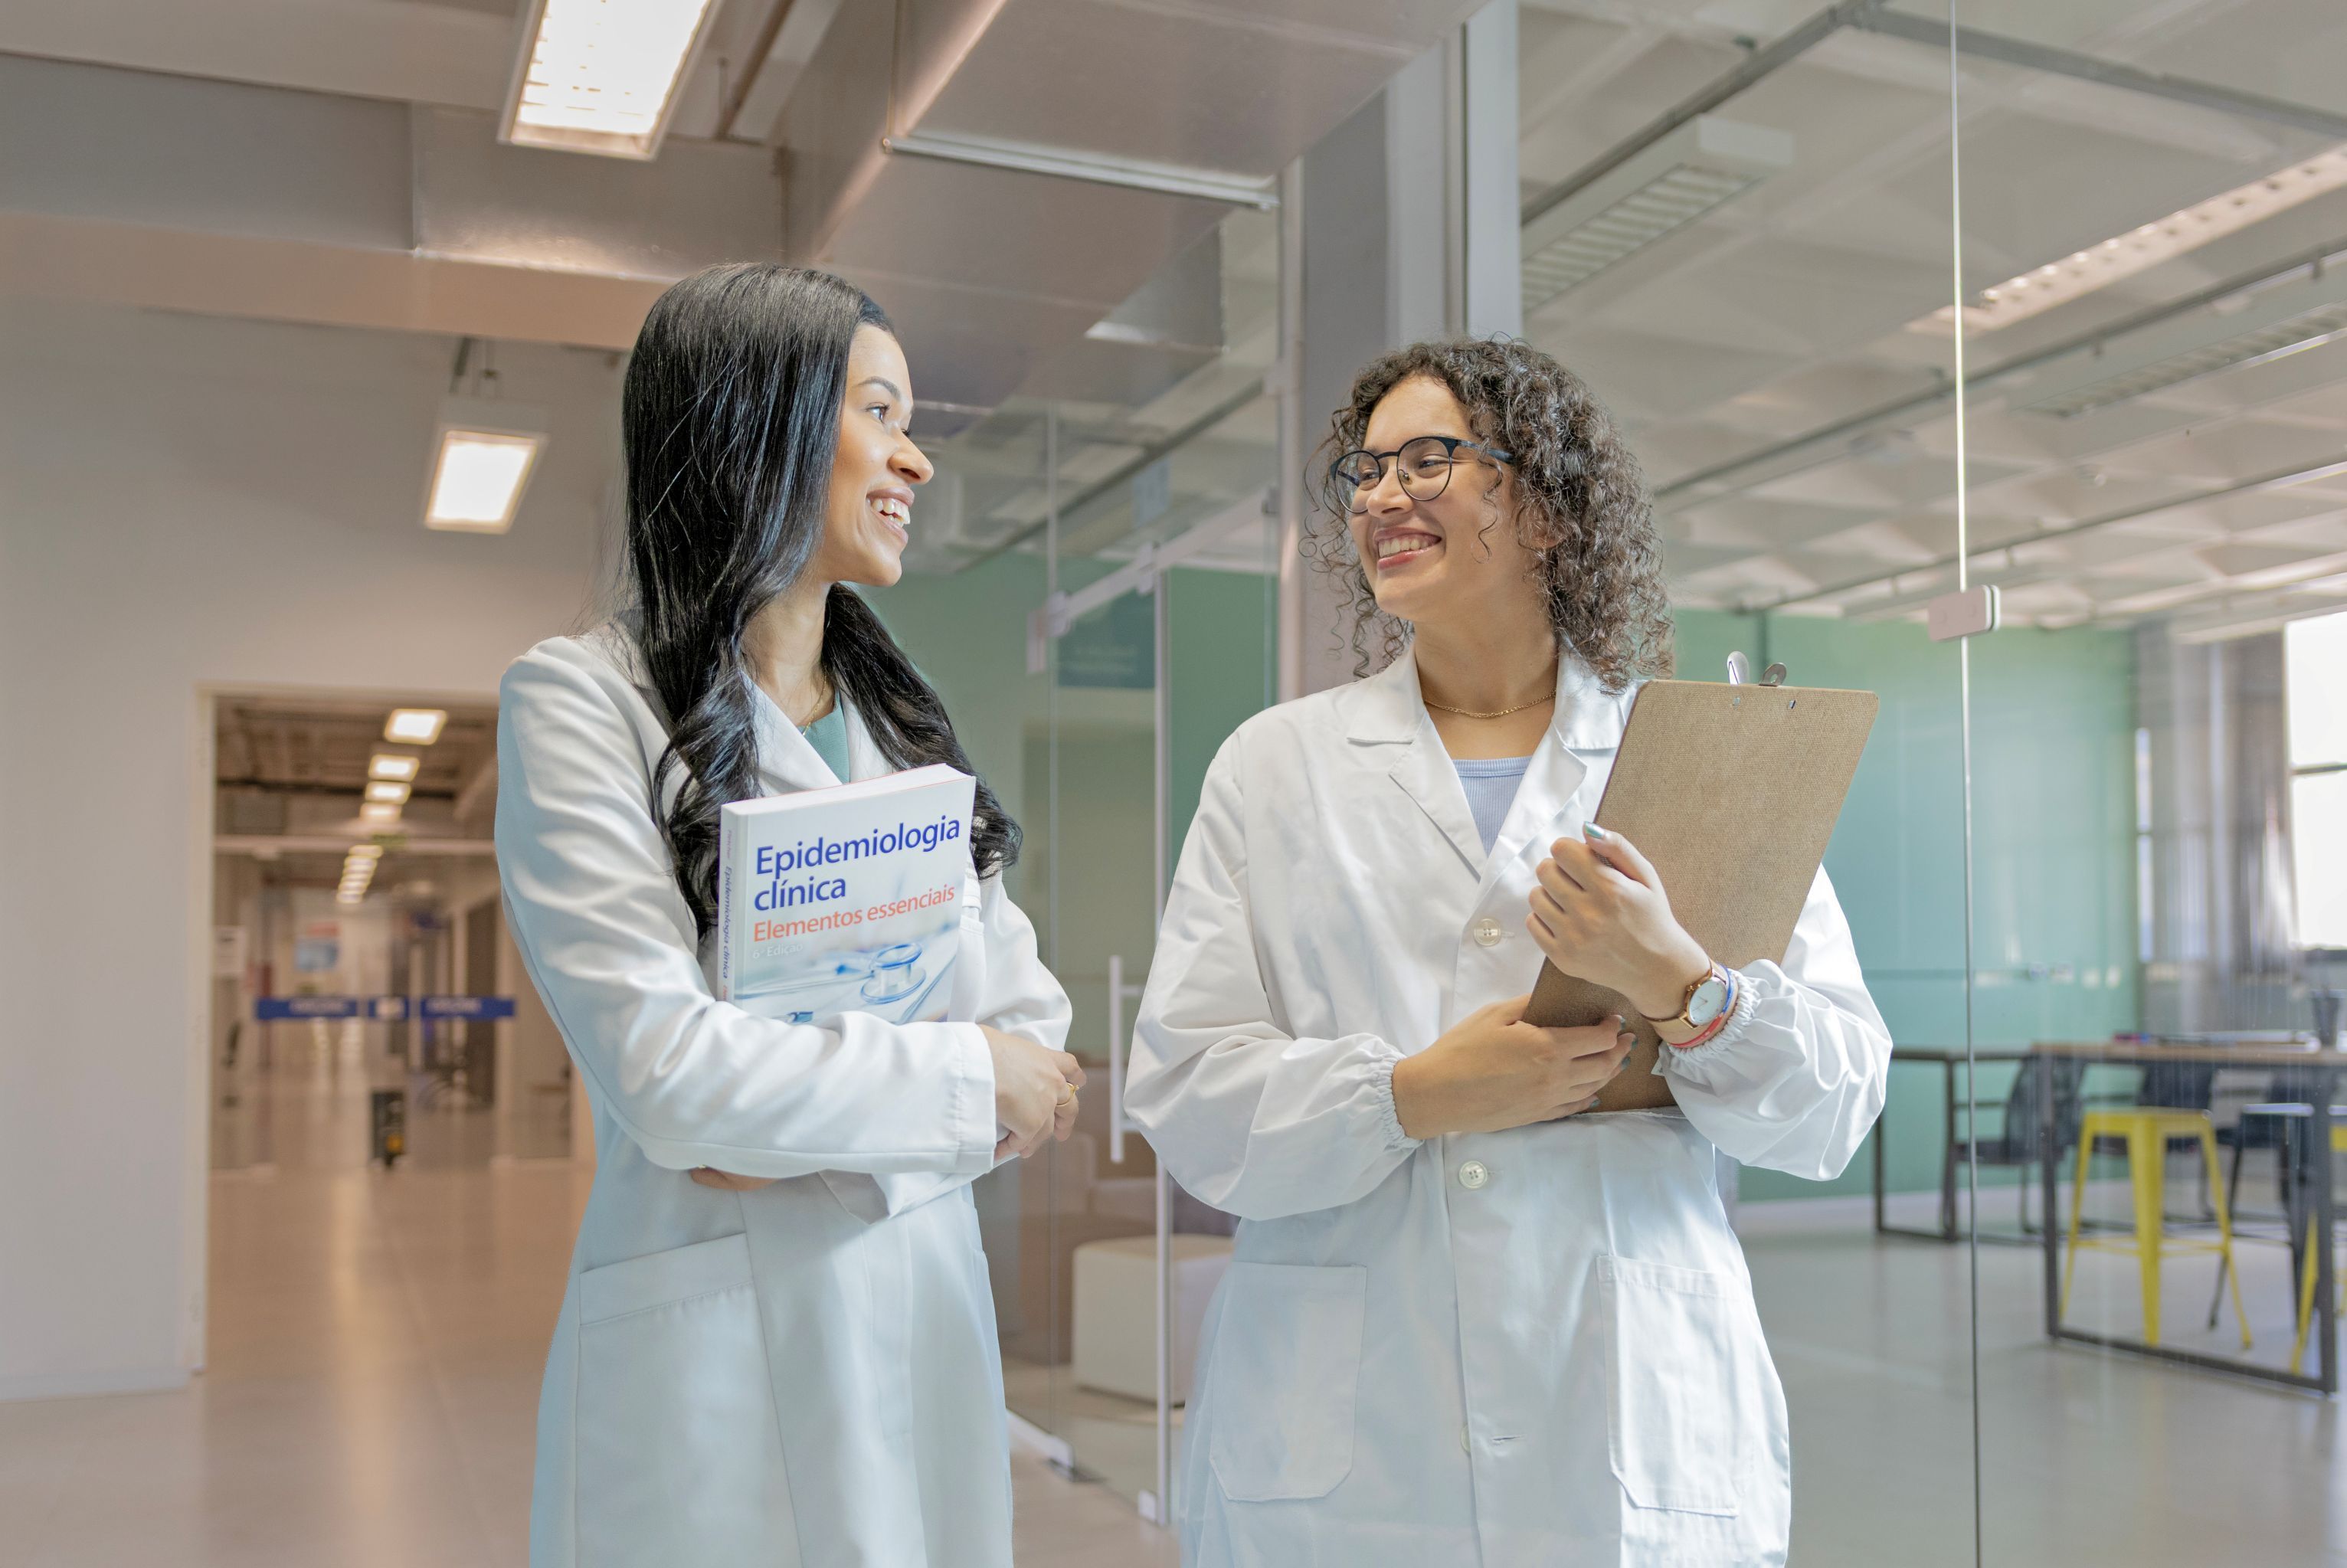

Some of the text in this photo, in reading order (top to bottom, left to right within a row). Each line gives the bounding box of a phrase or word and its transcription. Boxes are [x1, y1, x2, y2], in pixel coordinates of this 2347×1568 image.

[756, 815, 961, 879] Epidemiologia
[723, 866, 732, 944] Epidemiologia
[753, 884, 955, 942] Elementos essenciais
[754, 875, 846, 912] clínica
